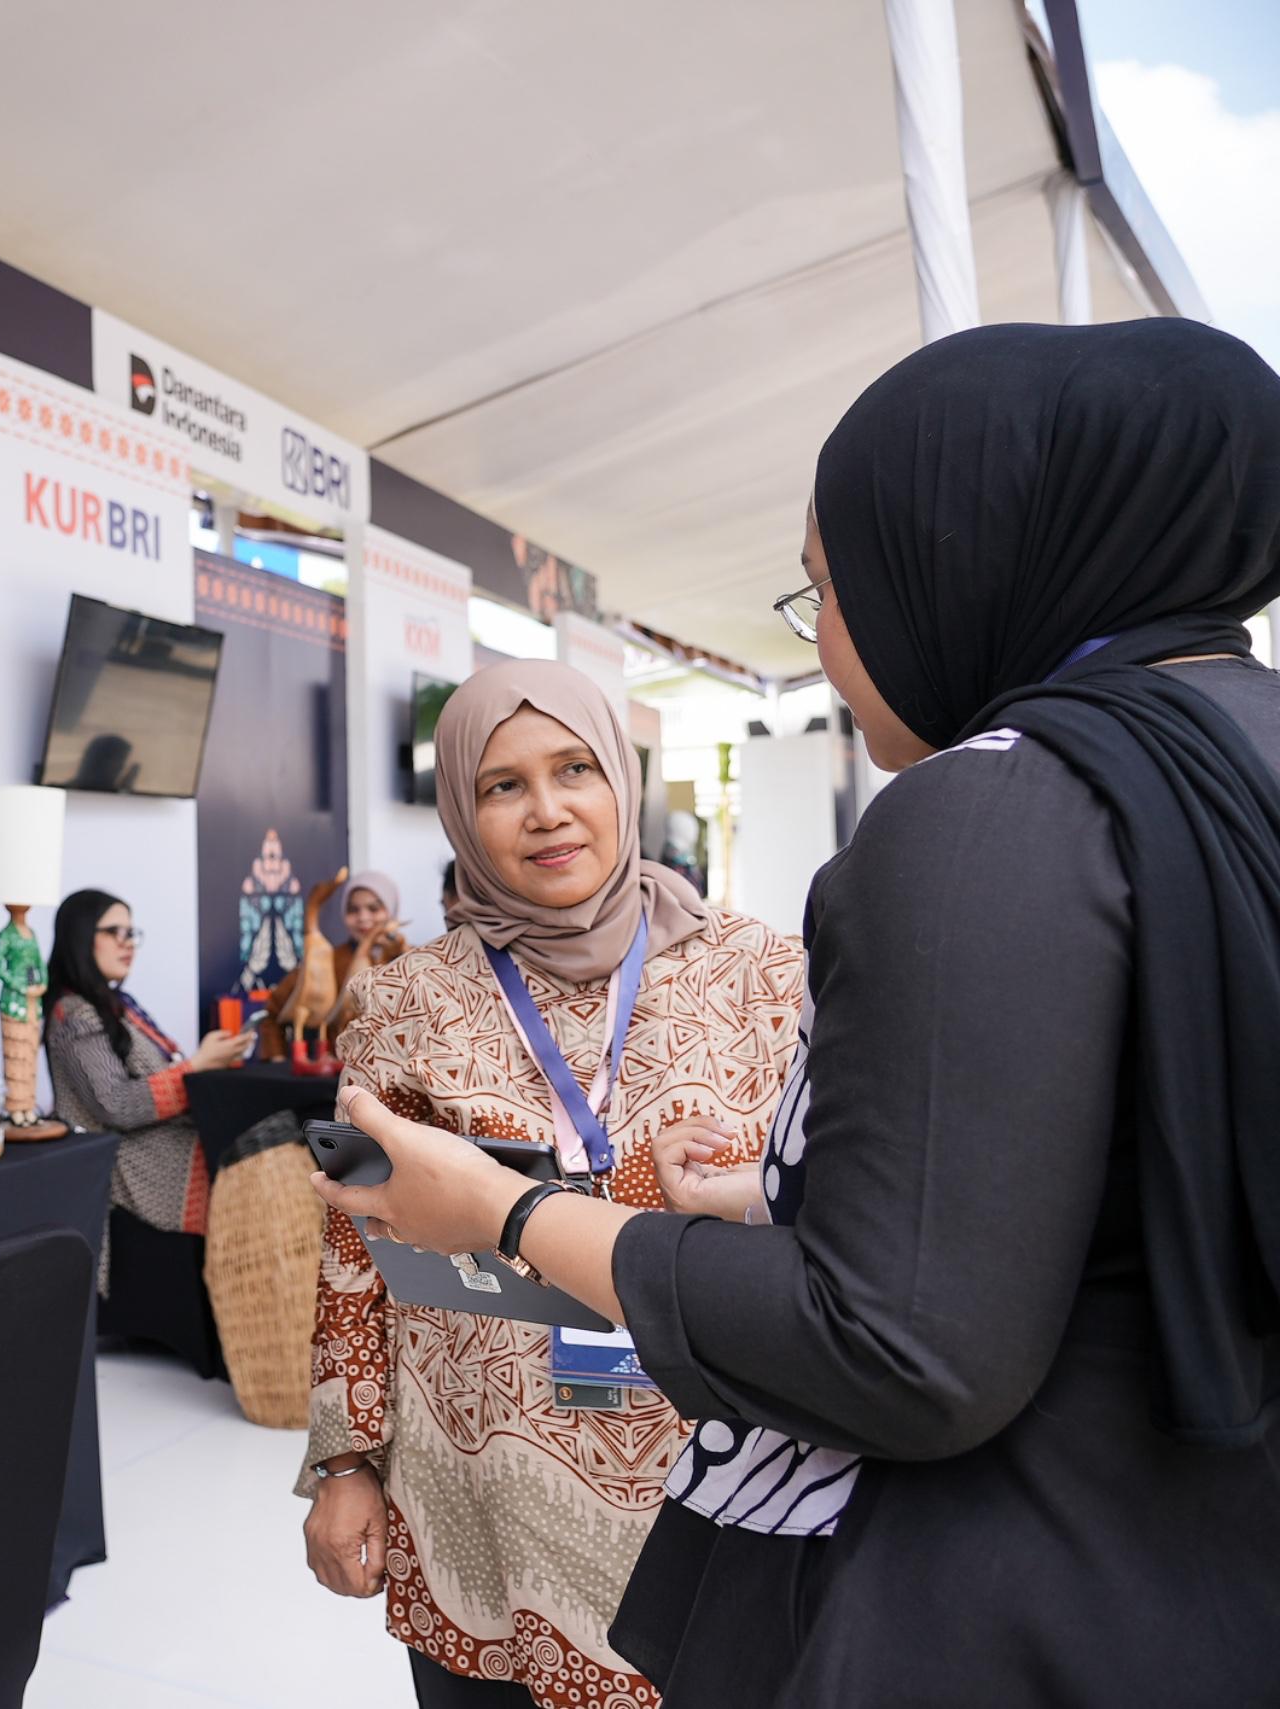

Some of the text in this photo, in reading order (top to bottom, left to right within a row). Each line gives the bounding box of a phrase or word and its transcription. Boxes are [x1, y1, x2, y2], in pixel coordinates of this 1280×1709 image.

[162, 367, 247, 432] Danantara
[162, 401, 242, 462] Indonesia
[310, 446, 350, 510] BRI
